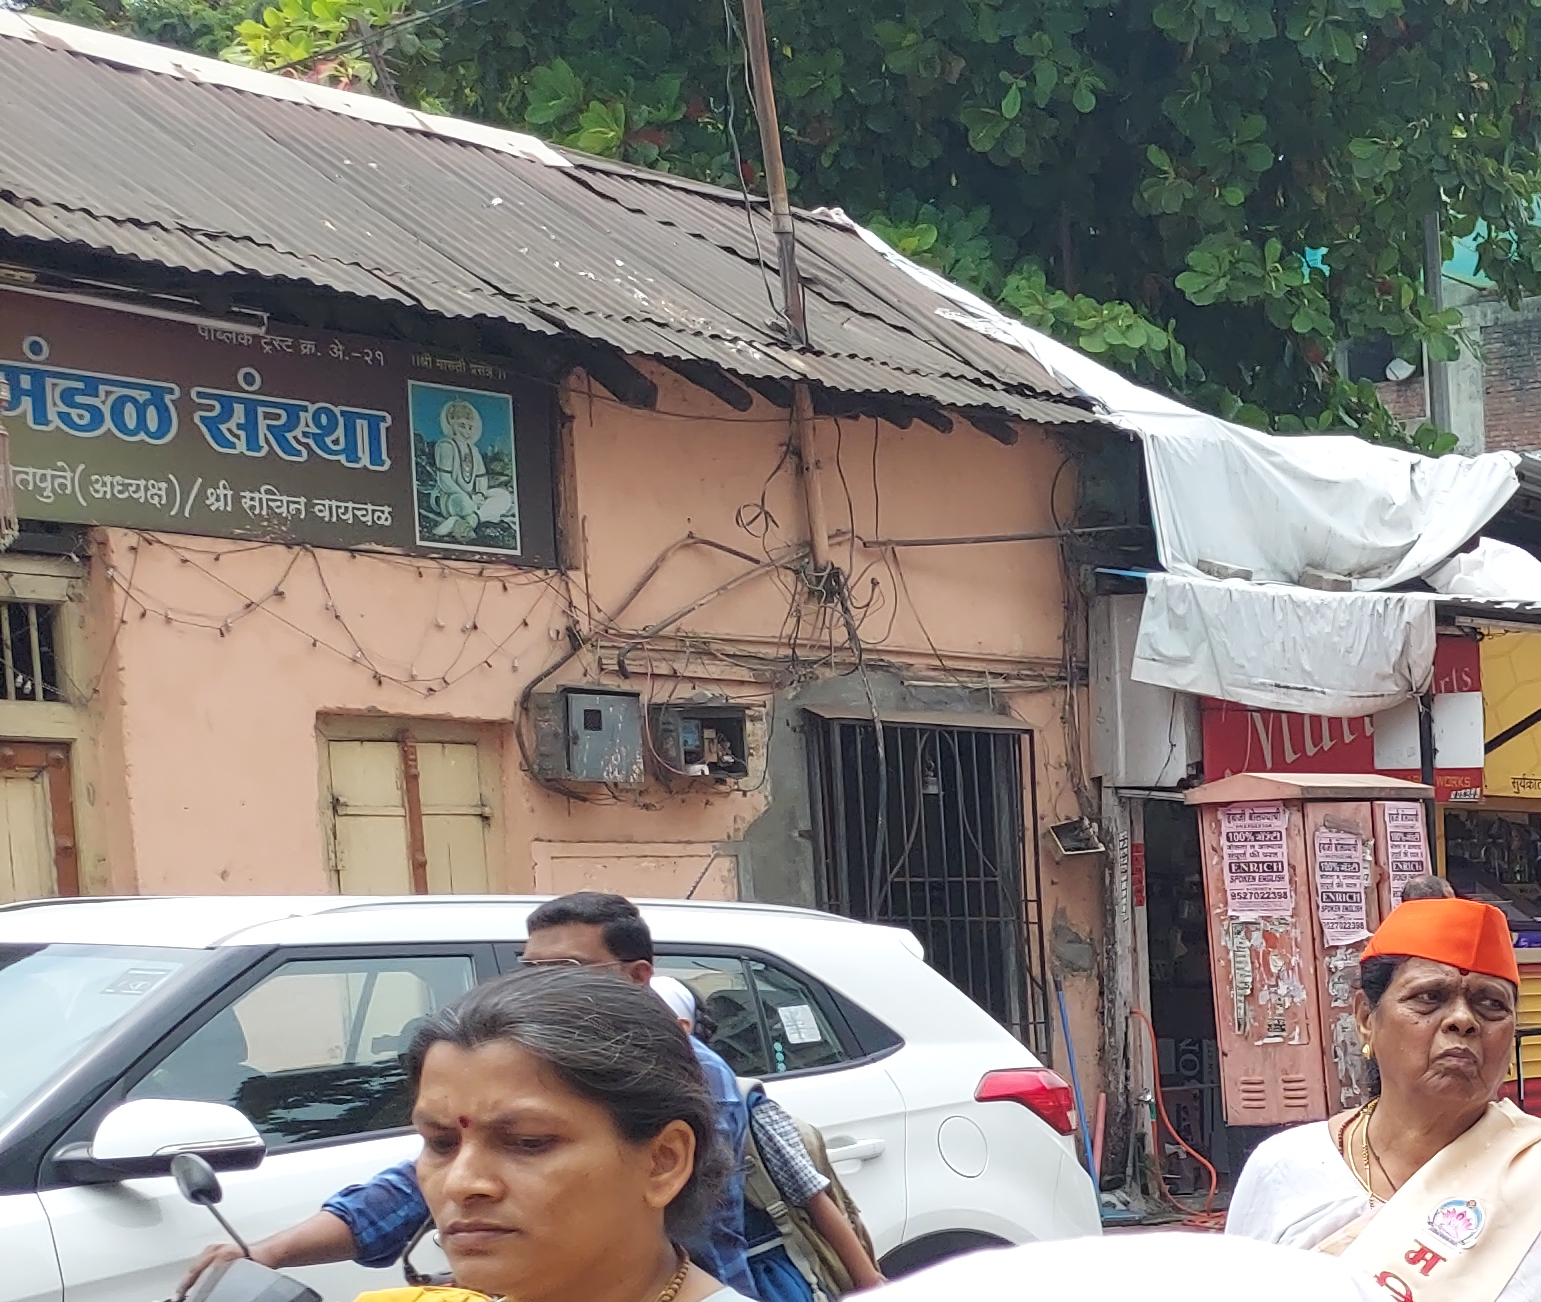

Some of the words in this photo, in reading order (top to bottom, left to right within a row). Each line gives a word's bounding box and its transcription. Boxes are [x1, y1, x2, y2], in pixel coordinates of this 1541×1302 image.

[190, 366, 392, 472] संस्था
[205, 479, 234, 513] श्री
[240, 485, 306, 522] सचिन
[1227, 831, 1255, 842] 100%
[1230, 861, 1283, 873] ENRICH
[1392, 861, 1424, 872] ENRICH
[1229, 875, 1257, 884] SPOKEN
[1257, 874, 1286, 882] ENGLISH
[1230, 891, 1289, 900] 9527022398
[1322, 892, 1361, 903] ENRICH
